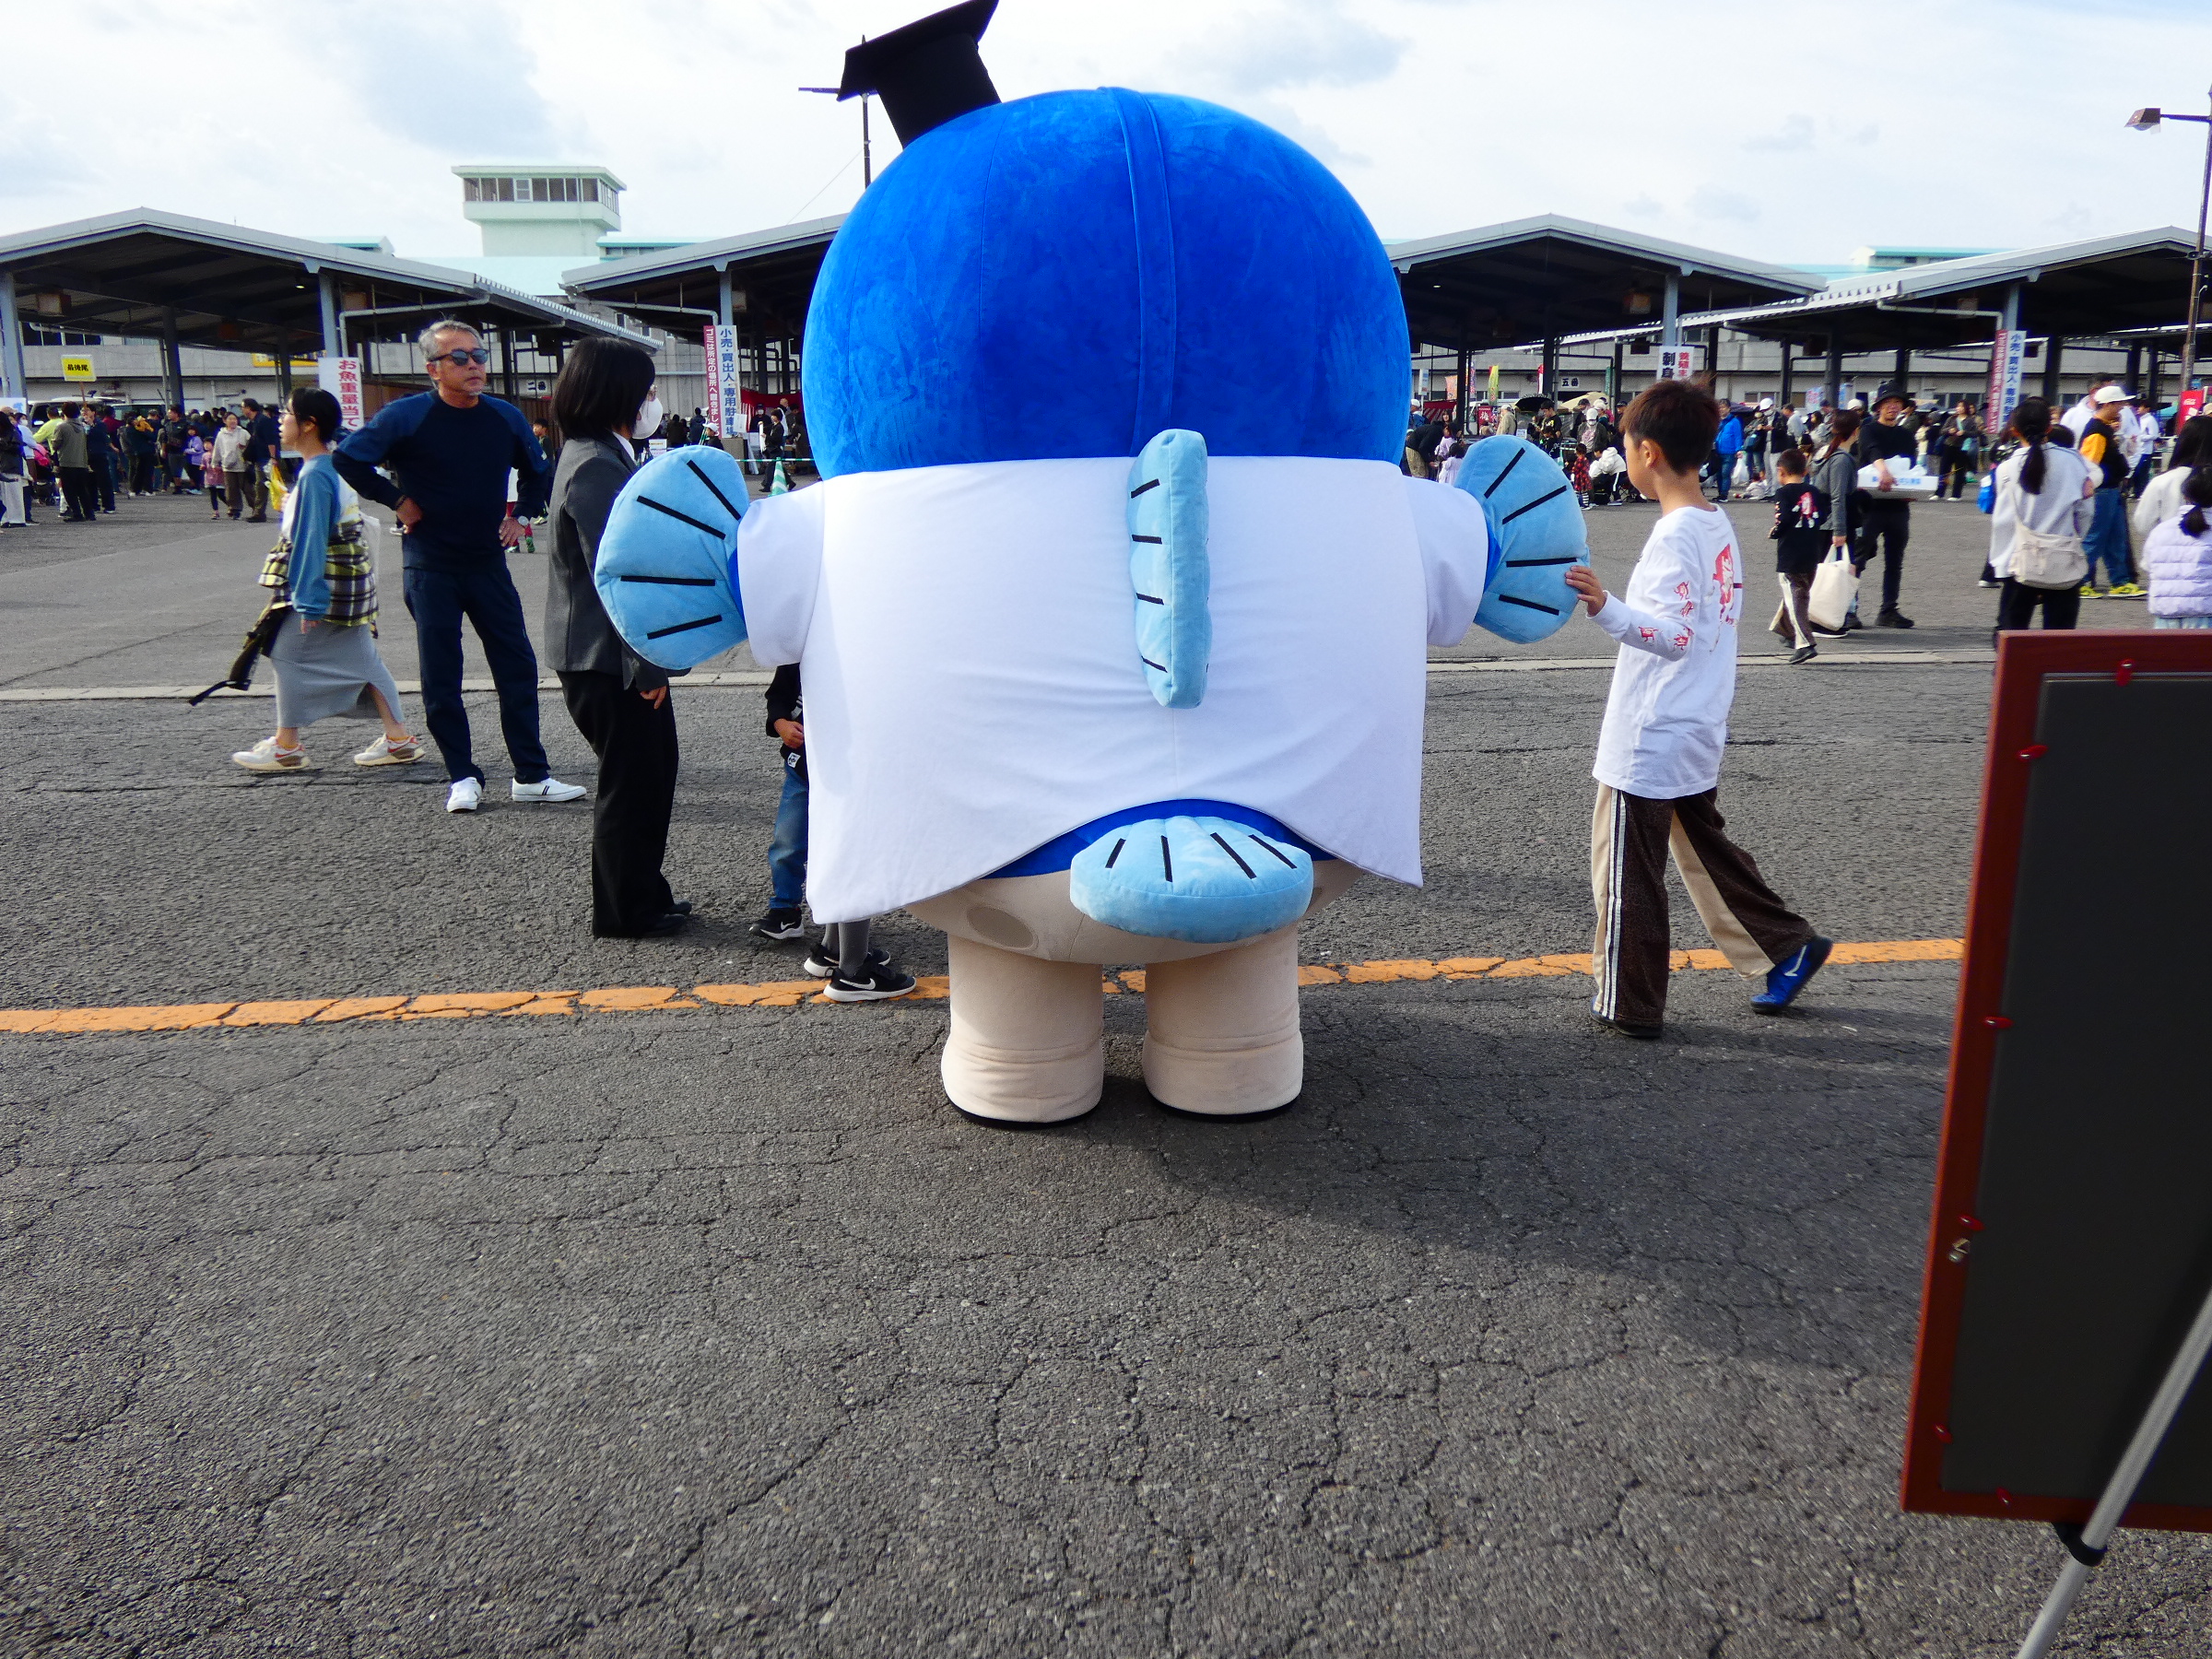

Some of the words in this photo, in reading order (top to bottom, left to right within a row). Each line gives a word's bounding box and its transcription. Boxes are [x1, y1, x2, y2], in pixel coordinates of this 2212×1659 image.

[338, 359, 359, 432] お魚重量当て
